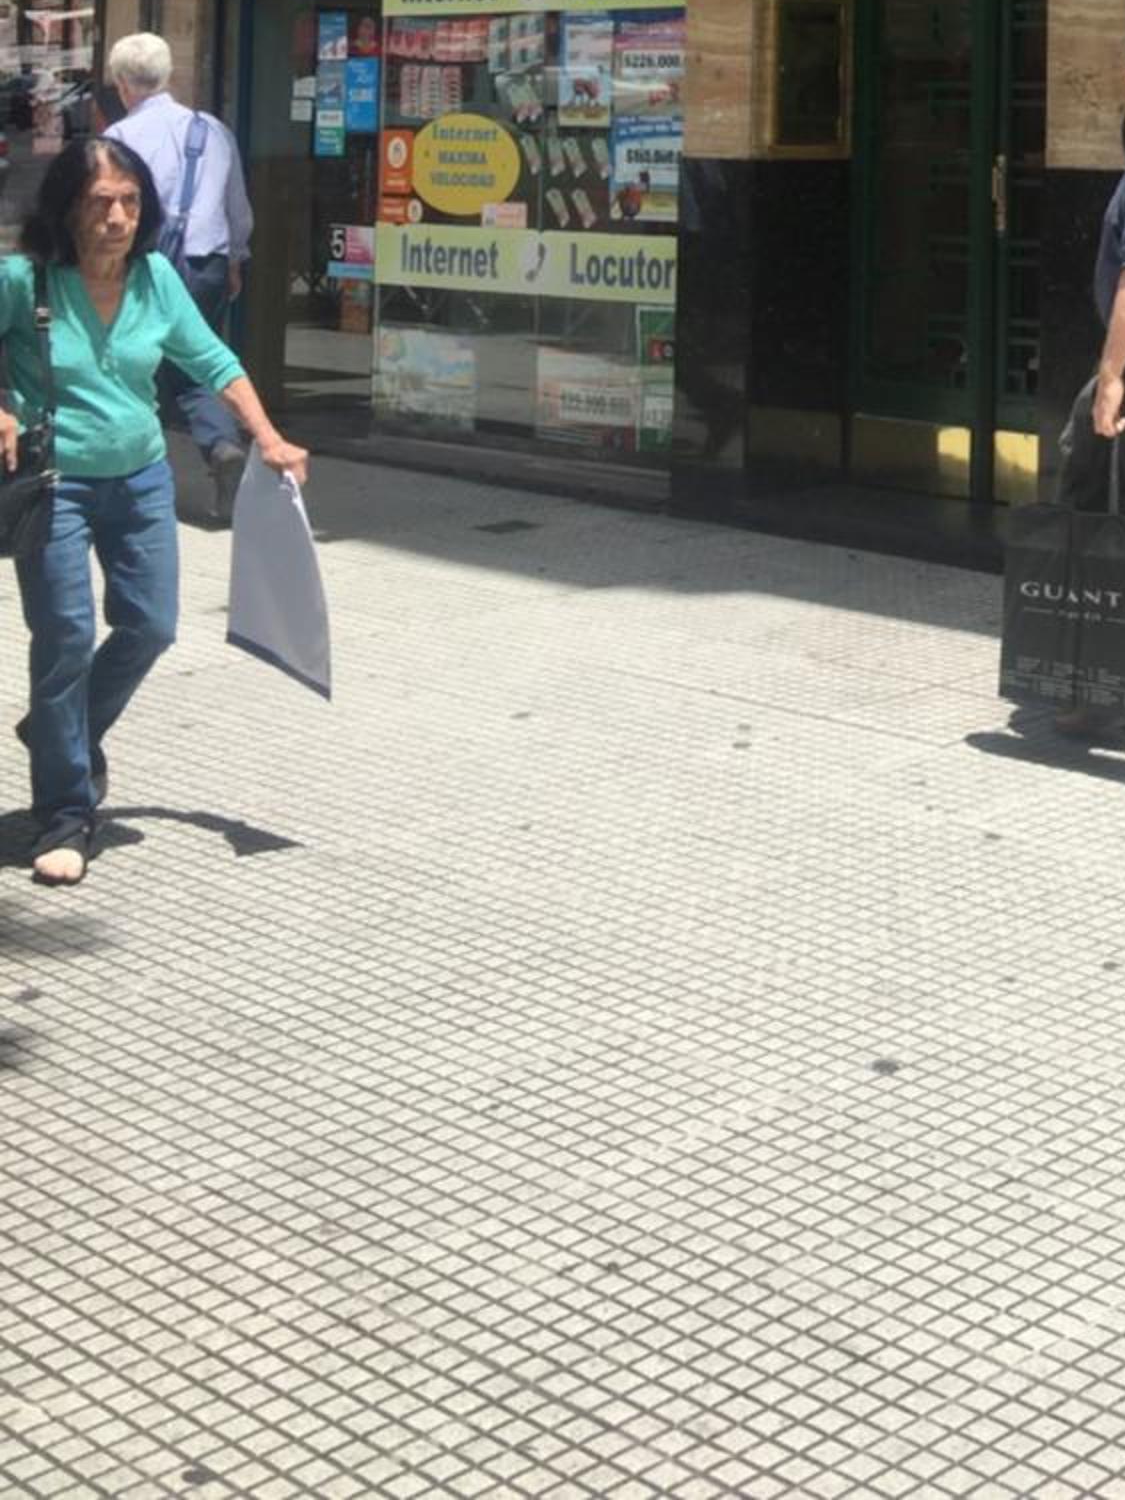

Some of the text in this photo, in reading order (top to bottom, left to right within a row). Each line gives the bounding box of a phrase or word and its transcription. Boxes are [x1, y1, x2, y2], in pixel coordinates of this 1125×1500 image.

[432, 123, 497, 141] Internet
[330, 229, 345, 259] 5
[400, 231, 499, 279] Internet
